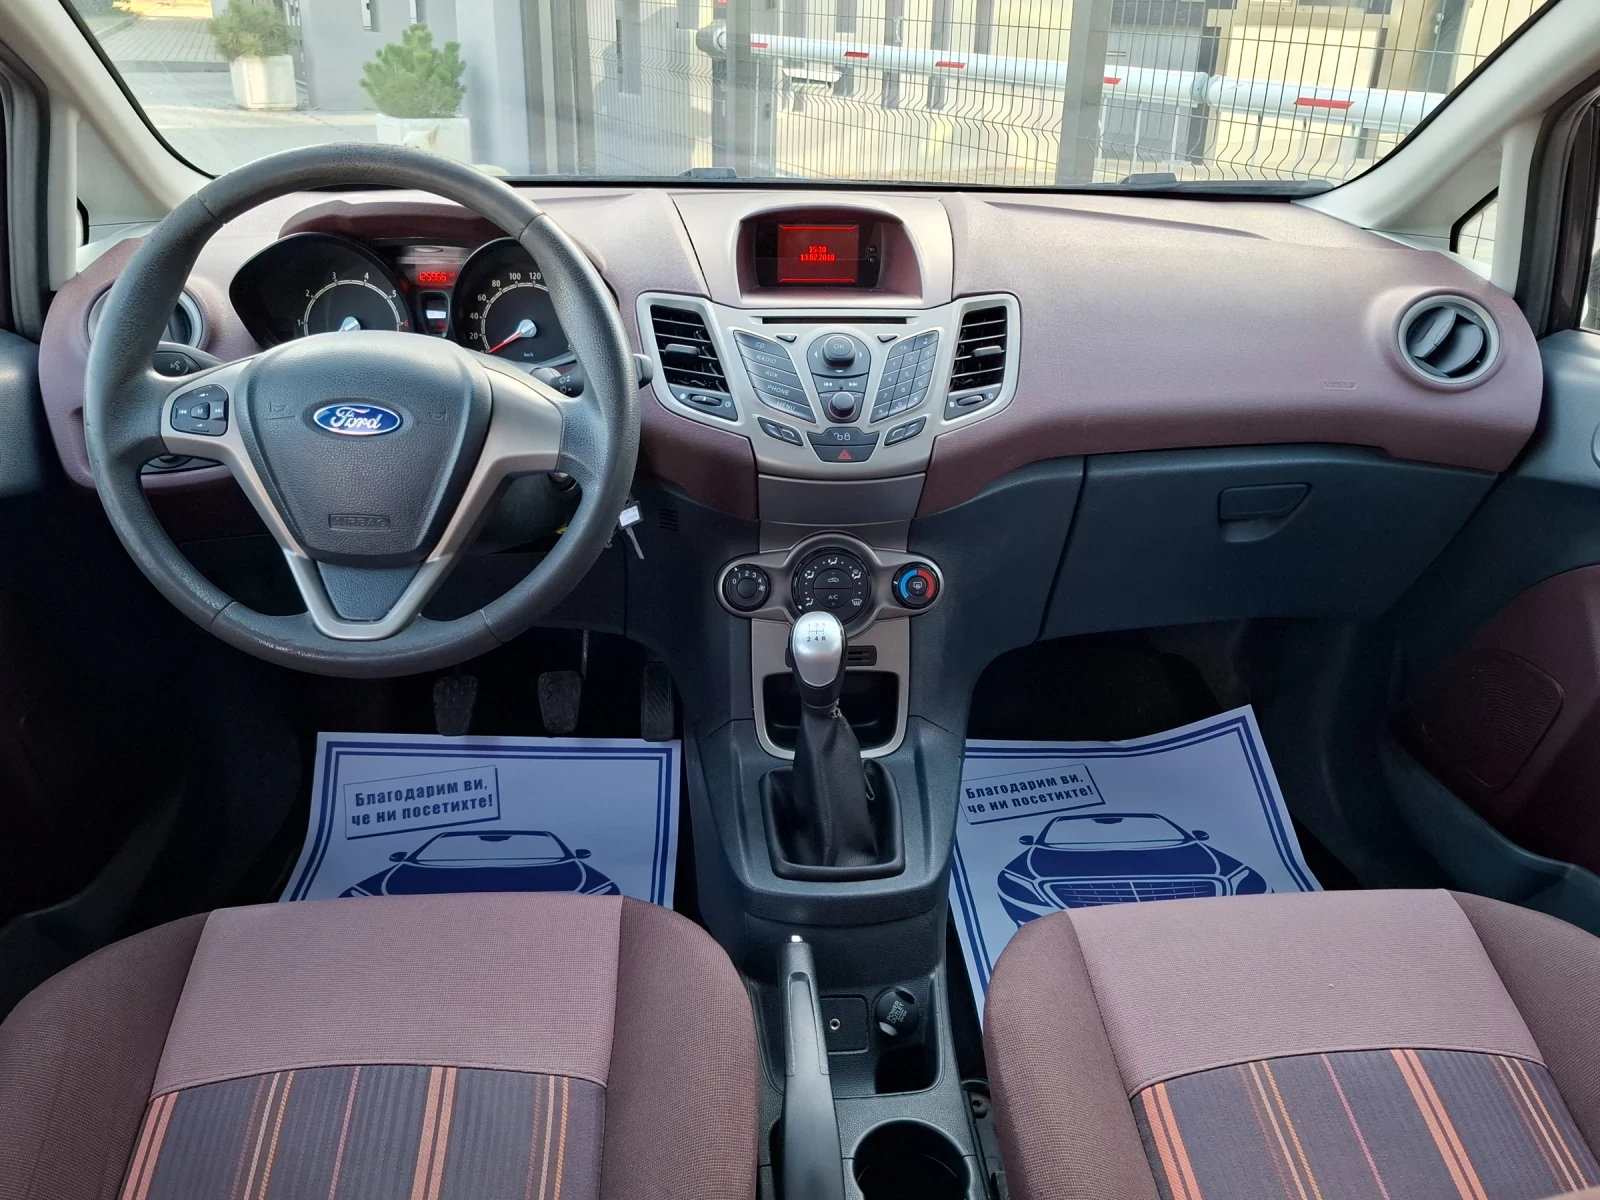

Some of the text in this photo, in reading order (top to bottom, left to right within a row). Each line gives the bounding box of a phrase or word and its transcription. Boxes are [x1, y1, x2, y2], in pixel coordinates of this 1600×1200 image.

[756, 354, 777, 364] RADIO
[768, 384, 790, 396] PHONE
[776, 401, 796, 411] MENU
[330, 406, 382, 429] Ford
[356, 778, 488, 807] Благодарим ви,
[965, 777, 1058, 799] Благодарим
[352, 794, 493, 826] че ни посетихте!
[967, 785, 1094, 814] че ни посетихте!
[886, 1000, 900, 1021] POWER
[891, 1003, 904, 1023] OUTLET
